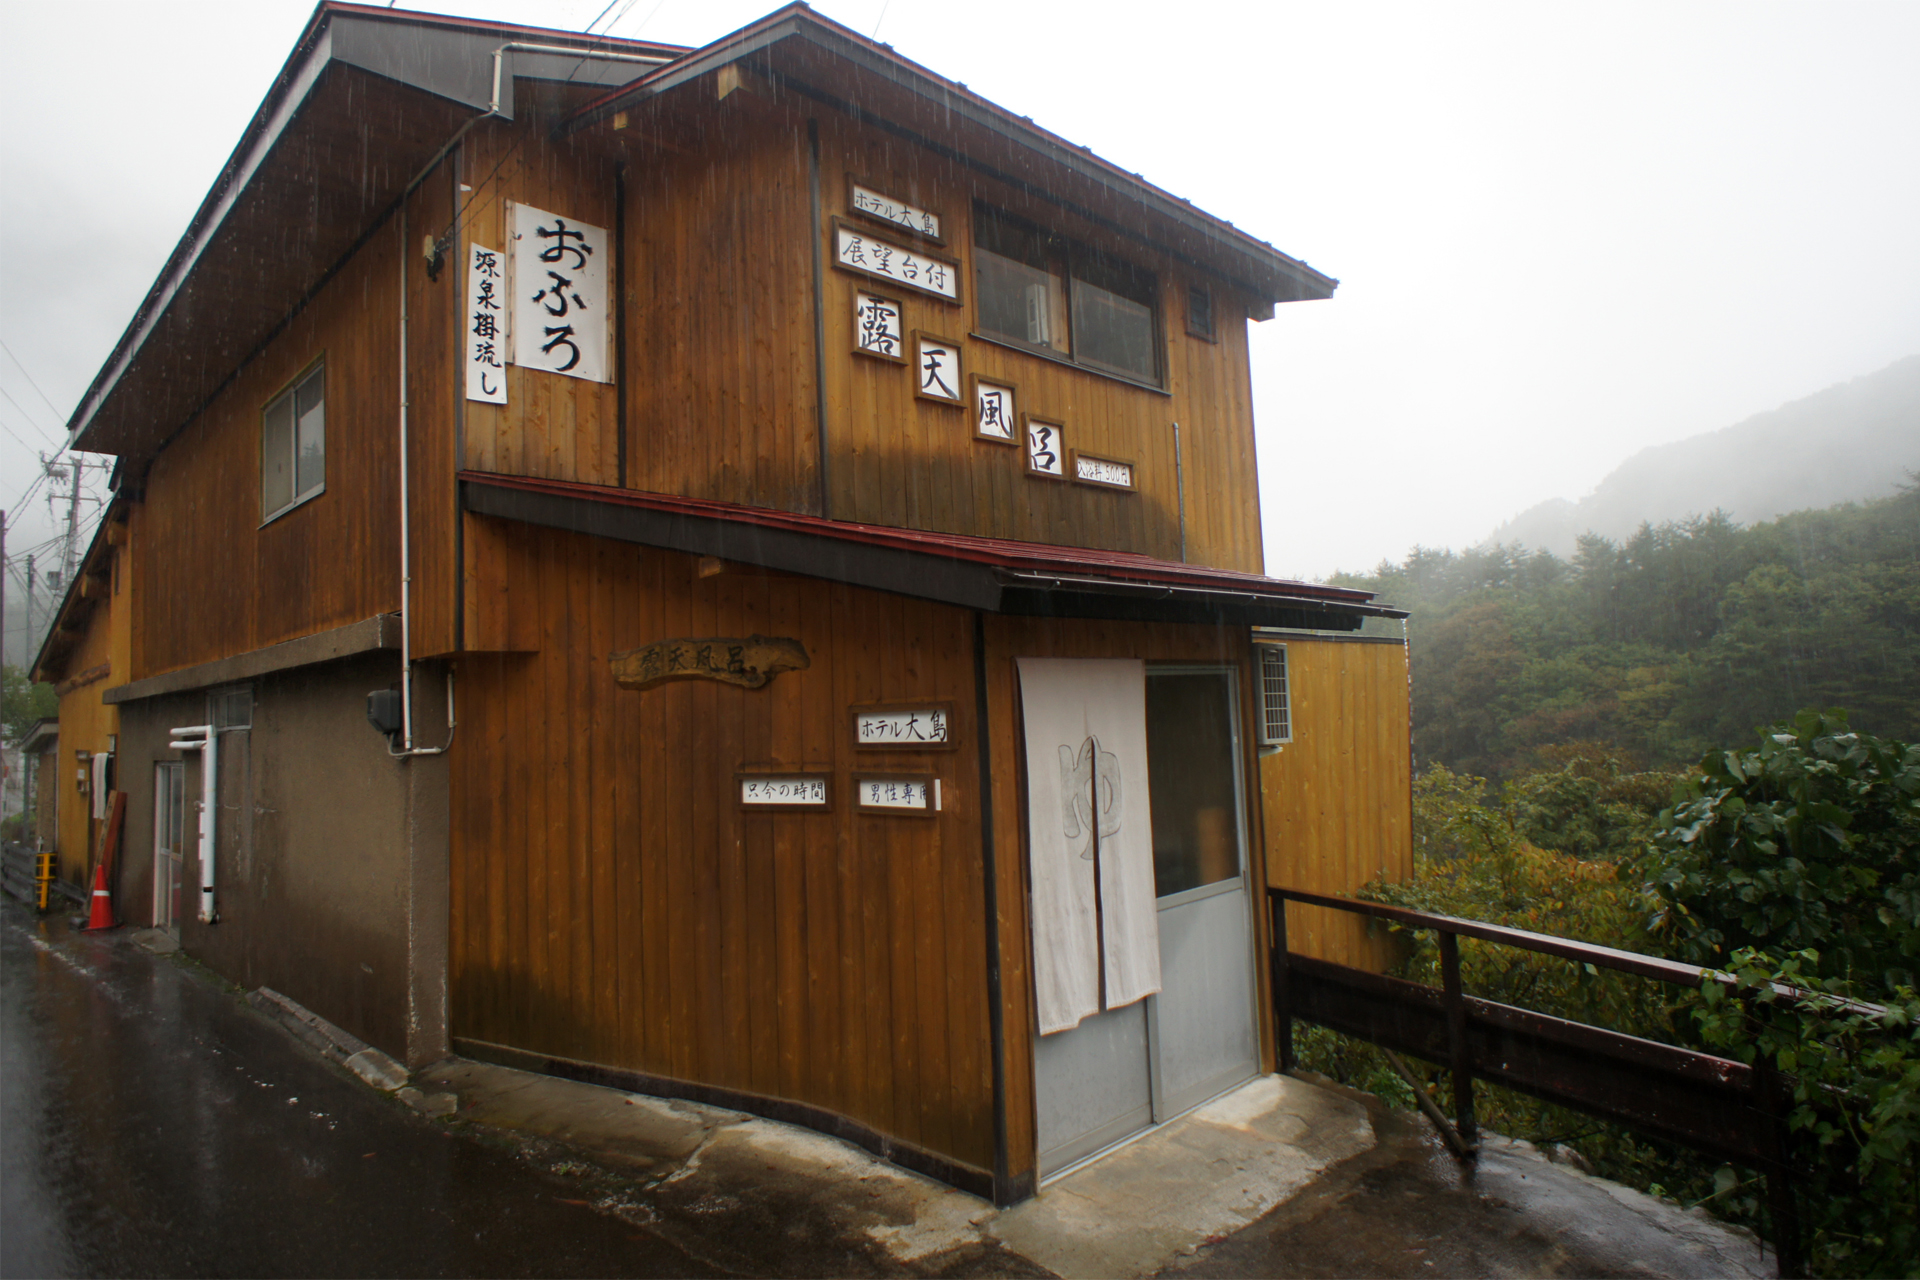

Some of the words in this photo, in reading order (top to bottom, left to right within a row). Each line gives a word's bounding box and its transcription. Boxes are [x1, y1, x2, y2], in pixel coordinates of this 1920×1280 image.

[855, 192, 936, 237] ホテル大島
[842, 236, 947, 290] 展望台付
[532, 219, 594, 372] おふろ
[473, 250, 503, 396] 源泉掛流し
[862, 709, 947, 742] ホテル大島
[748, 781, 825, 801] 只今の時間
[1058, 734, 1123, 861] ゆ
